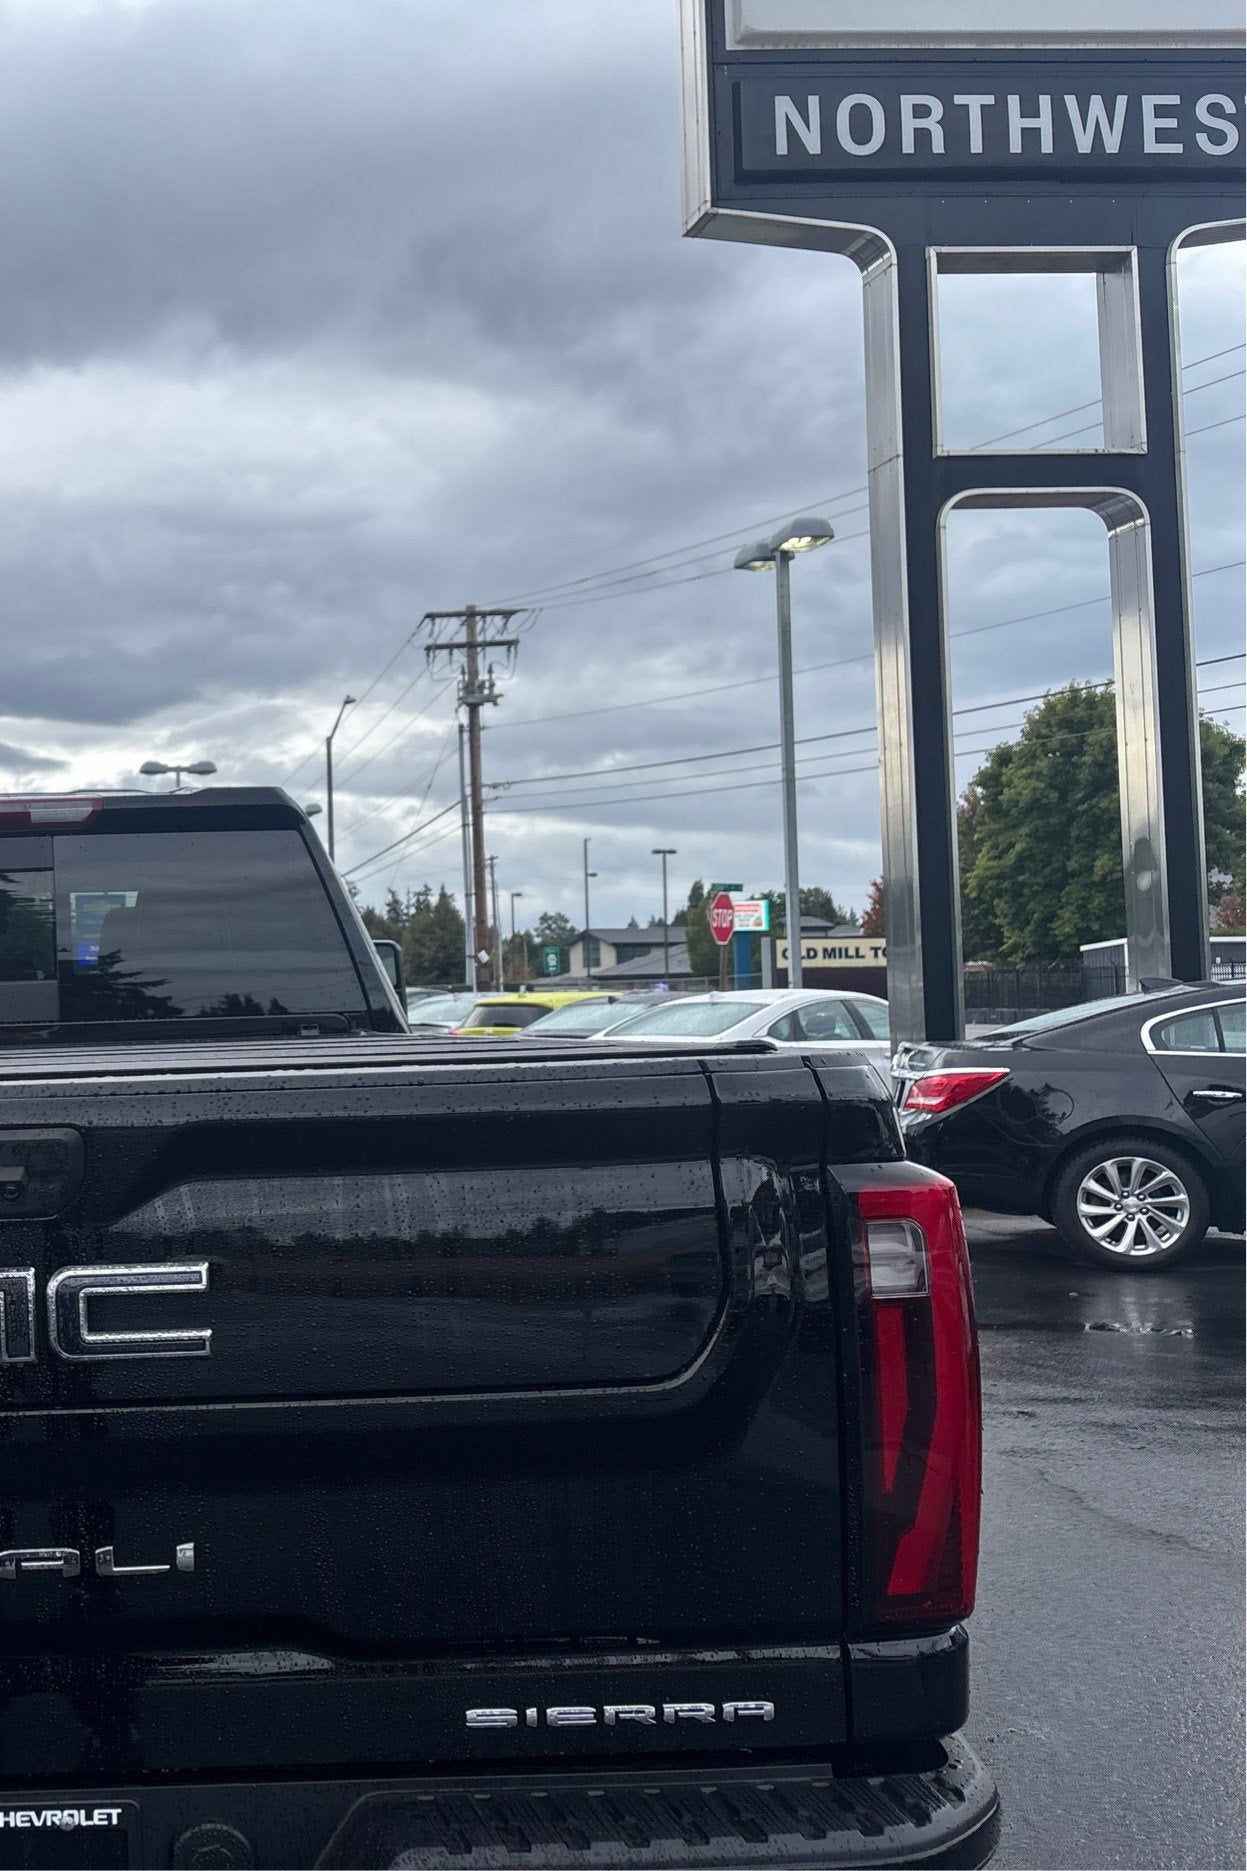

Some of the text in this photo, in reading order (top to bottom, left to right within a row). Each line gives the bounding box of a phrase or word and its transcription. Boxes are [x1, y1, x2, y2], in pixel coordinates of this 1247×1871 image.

[774, 93, 1246, 156] NORTHWES
[712, 908, 733, 928] STOP
[822, 946, 865, 959] MILL
[465, 1701, 775, 1727] SIERRA
